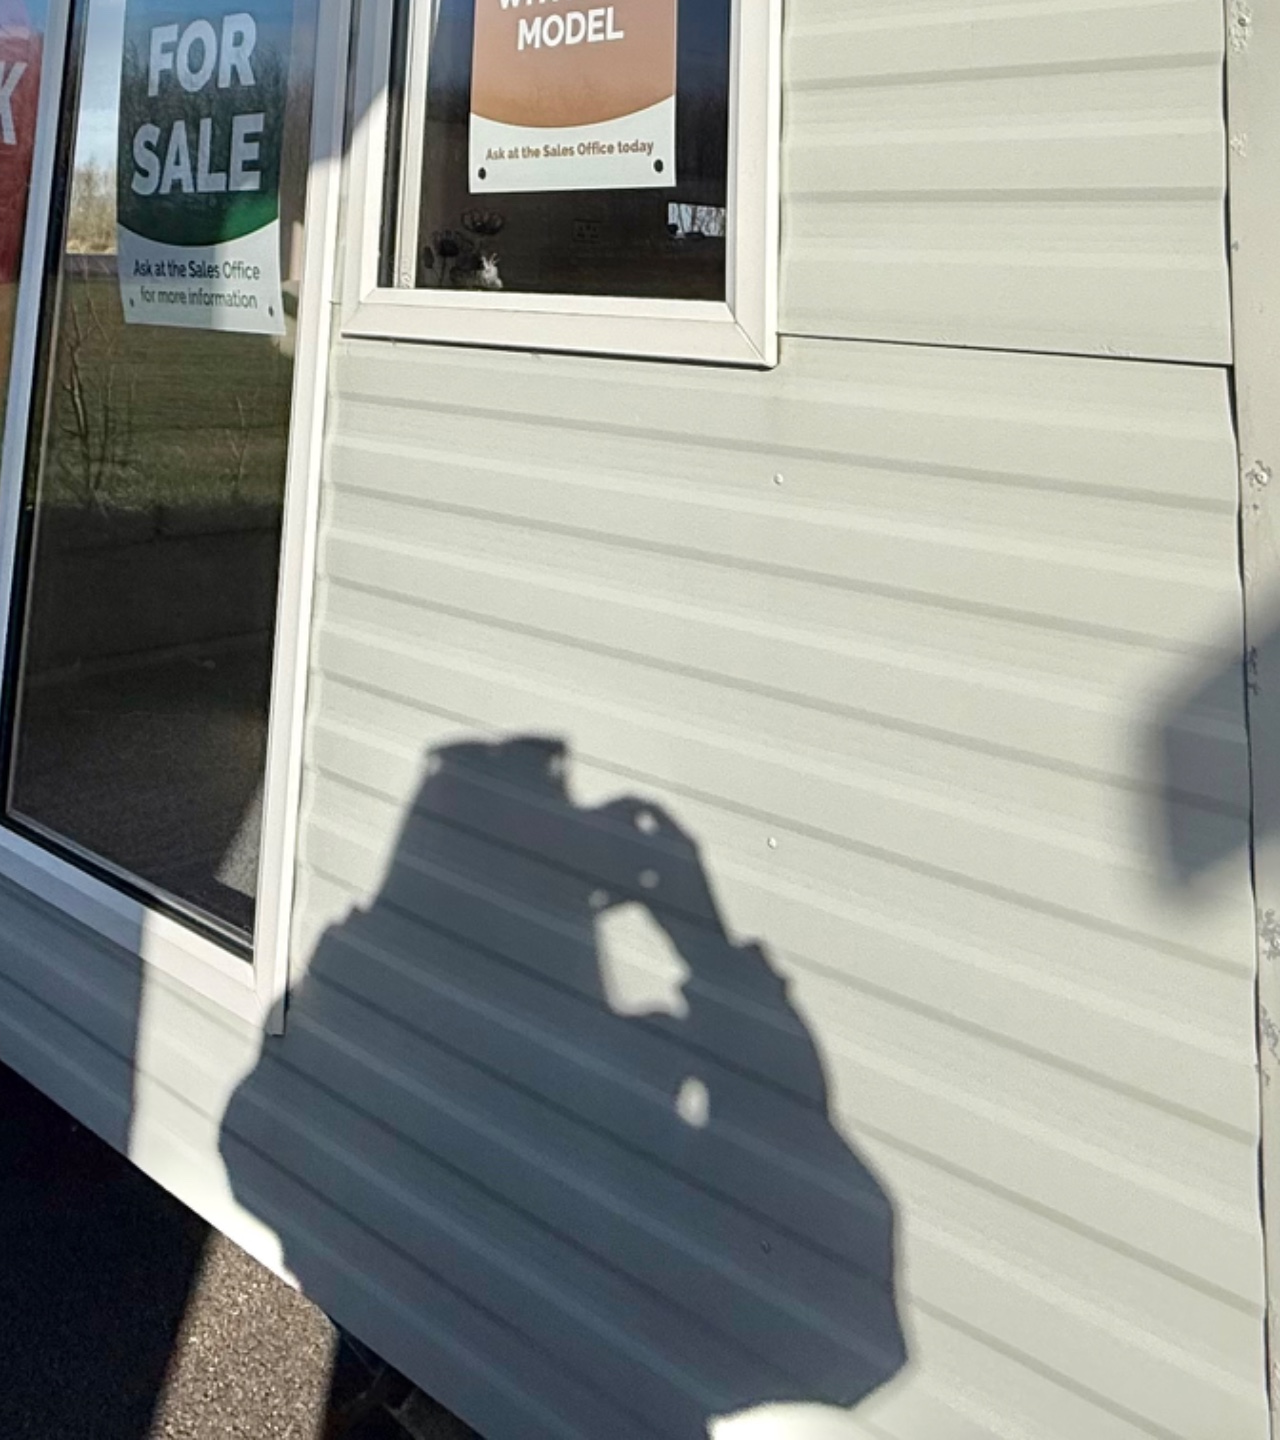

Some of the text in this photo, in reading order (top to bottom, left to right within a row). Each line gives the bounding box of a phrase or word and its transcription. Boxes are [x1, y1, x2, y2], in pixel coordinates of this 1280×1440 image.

[517, 6, 625, 51] MODEL
[148, 12, 256, 98] FOR
[131, 112, 265, 196] SALE
[486, 139, 655, 160] Ask at the Sales Office today
[133, 259, 261, 281] Ask at the Sales Office
[140, 286, 258, 309] for more information
